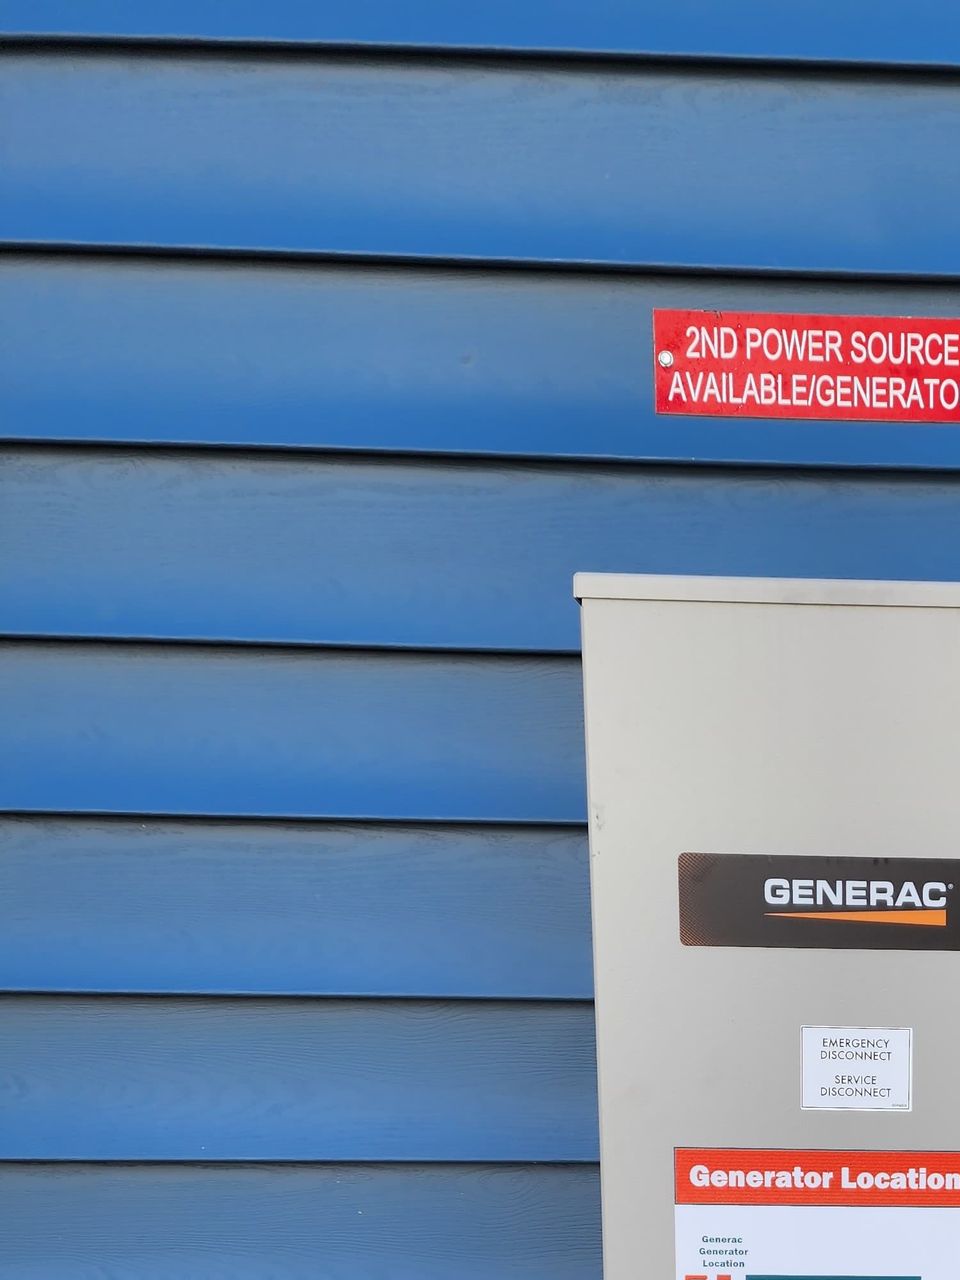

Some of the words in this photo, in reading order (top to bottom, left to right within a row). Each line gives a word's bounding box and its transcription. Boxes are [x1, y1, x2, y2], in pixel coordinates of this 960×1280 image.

[685, 326, 737, 359] 2ND
[746, 328, 843, 362] POWER
[851, 331, 960, 366] SOURCE
[764, 878, 947, 907] GENERAC
[822, 1038, 890, 1049] EMERGENCY
[820, 1050, 892, 1061] DISCONNECT
[834, 1074, 877, 1085] SERVICE
[820, 1087, 892, 1098] DISCONNECT
[689, 1164, 834, 1189] Generator
[702, 1235, 743, 1244] Generac
[699, 1247, 749, 1256] Generator
[702, 1259, 745, 1268] Location
